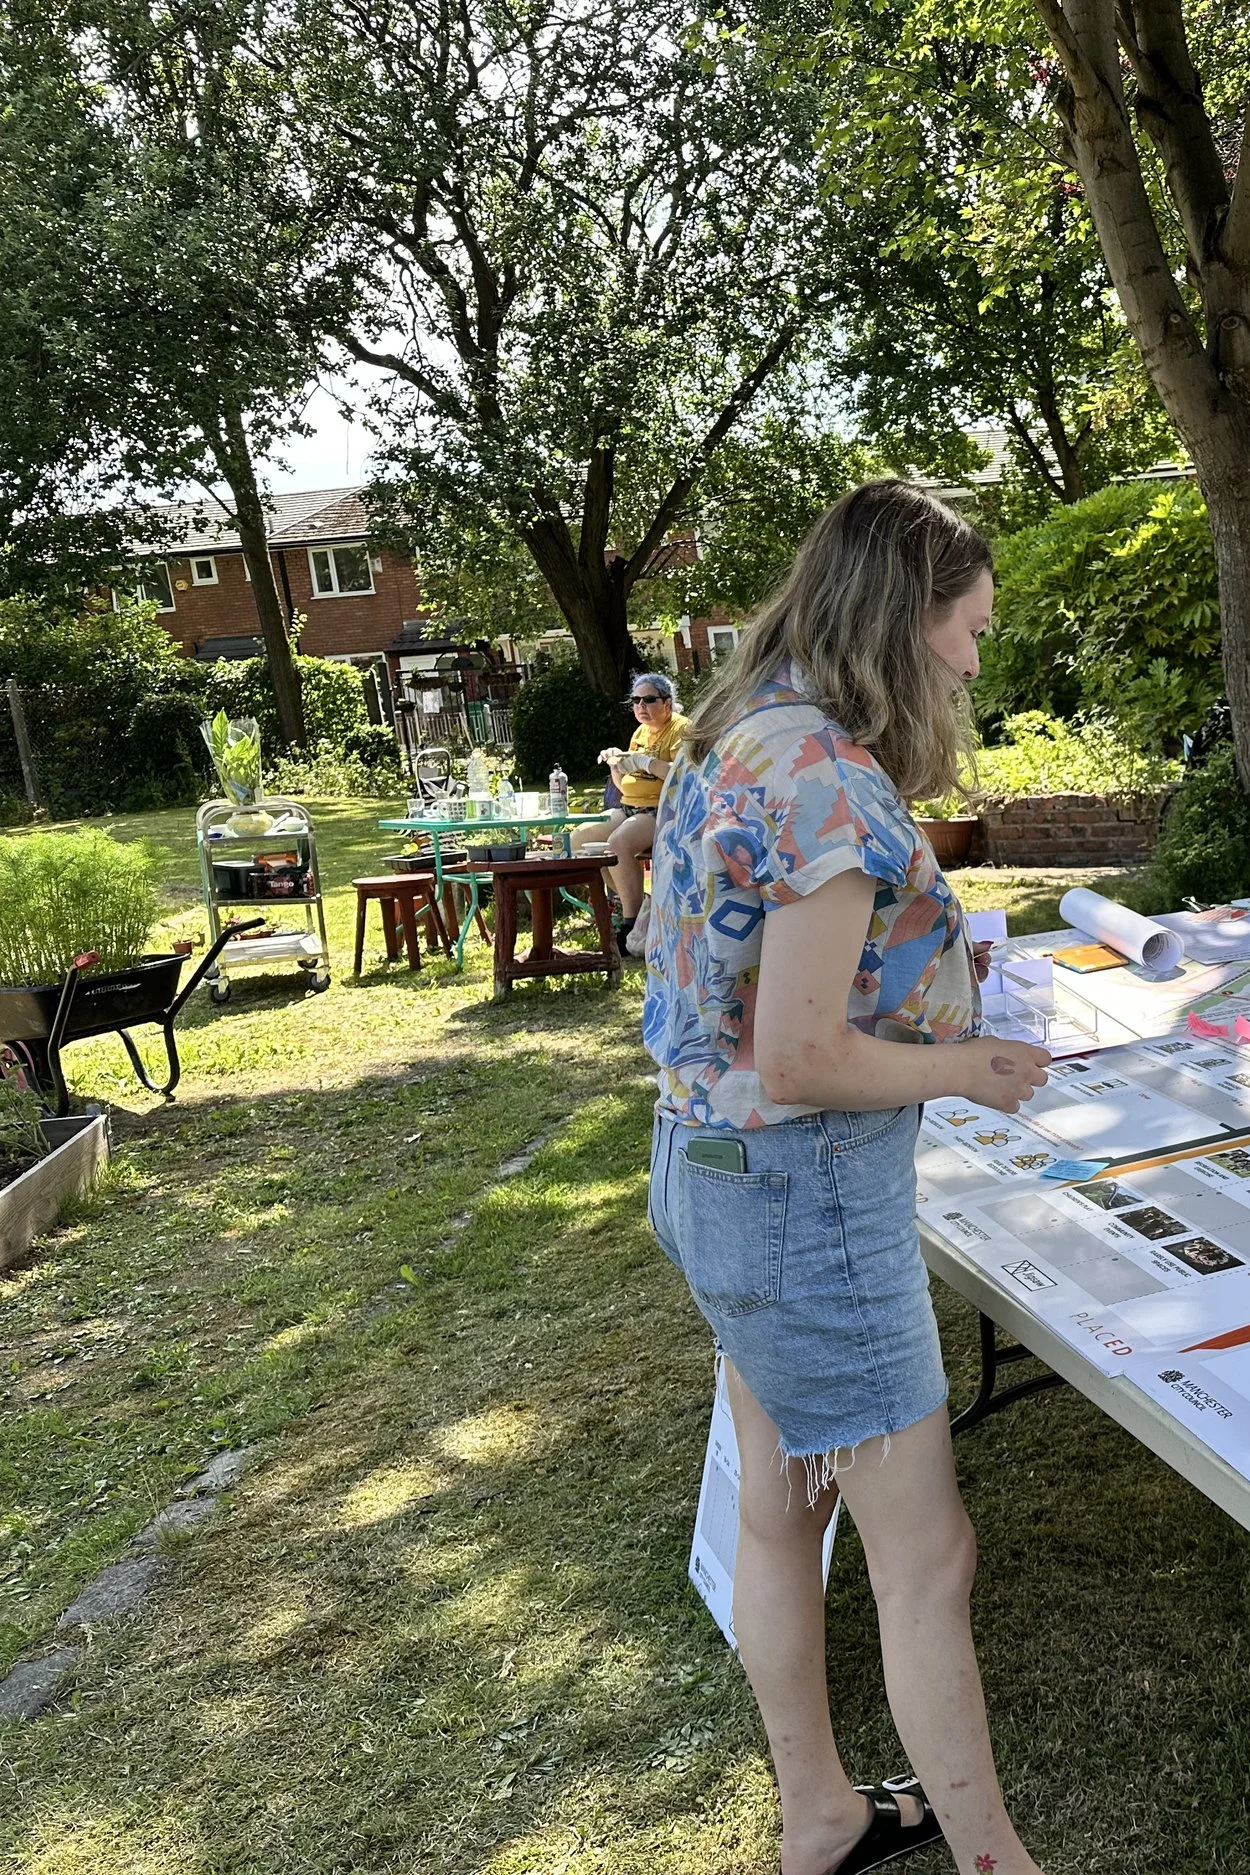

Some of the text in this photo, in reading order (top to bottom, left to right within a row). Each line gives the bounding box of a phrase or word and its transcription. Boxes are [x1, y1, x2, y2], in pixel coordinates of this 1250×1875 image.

[268, 880, 294, 888] Tango
[1021, 1271, 1046, 1287] Jigsaw
[1069, 1311, 1133, 1356] PLACED
[1170, 1383, 1207, 1412] CITY COUNCIL
[1180, 1379, 1233, 1420] MANCHESTER
